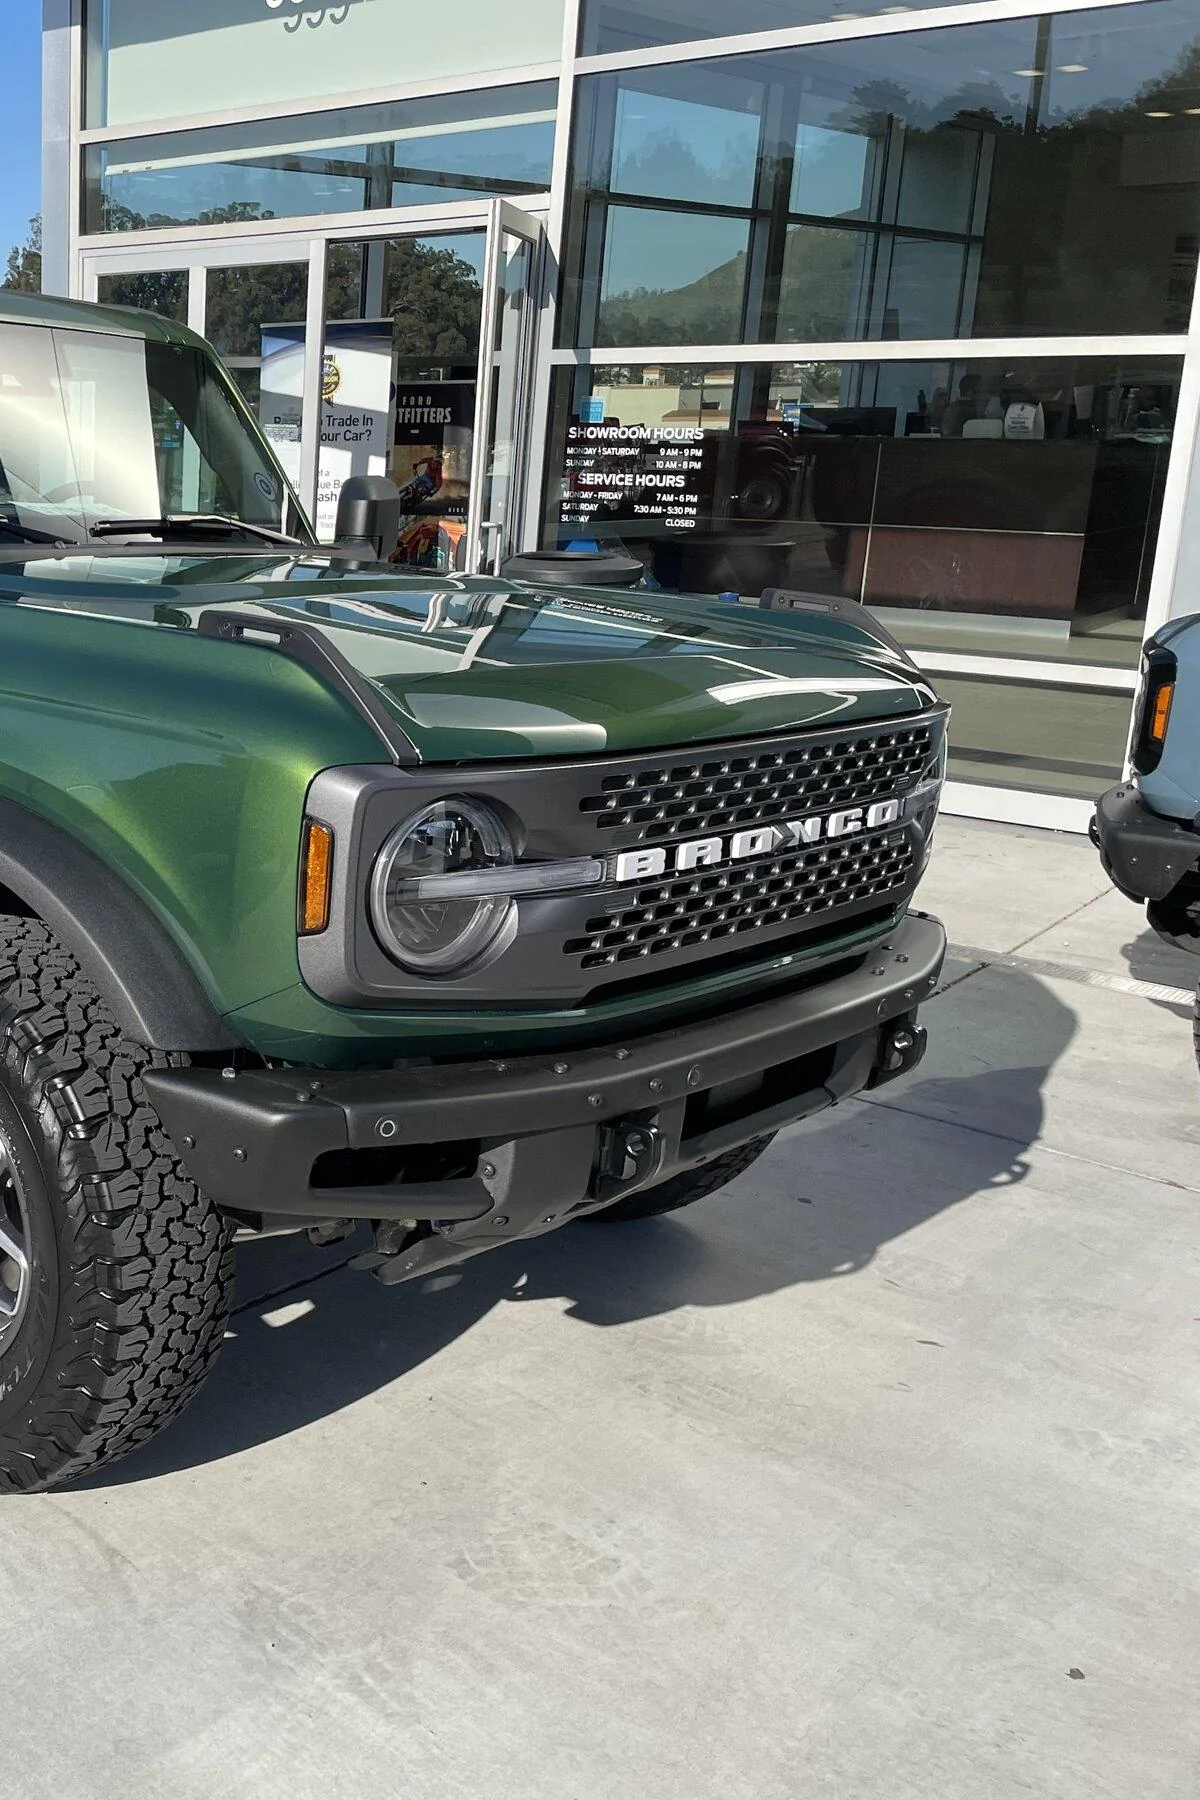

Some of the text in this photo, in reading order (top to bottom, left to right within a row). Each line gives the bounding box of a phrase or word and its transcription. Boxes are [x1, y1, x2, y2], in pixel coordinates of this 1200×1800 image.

[402, 396, 432, 405] FORD
[326, 414, 360, 427] Trade
[363, 415, 373, 427] In
[398, 407, 452, 423] TFITTERS
[321, 430, 372, 442] our Car?
[568, 427, 704, 440] SHOWROOM HOURS
[567, 447, 597, 455] MONDAY
[602, 447, 640, 456] SATURDAY
[666, 448, 679, 456] AM
[683, 448, 688, 456] 9
[578, 474, 685, 487] SERVICE HOURS
[318, 491, 338, 502] ash
[563, 491, 593, 499] MONDAY
[598, 492, 623, 500] FRIDAY
[562, 503, 598, 511] SATURDAY
[665, 519, 695, 527] CLOSED
[615, 799, 899, 882] BRONCO
